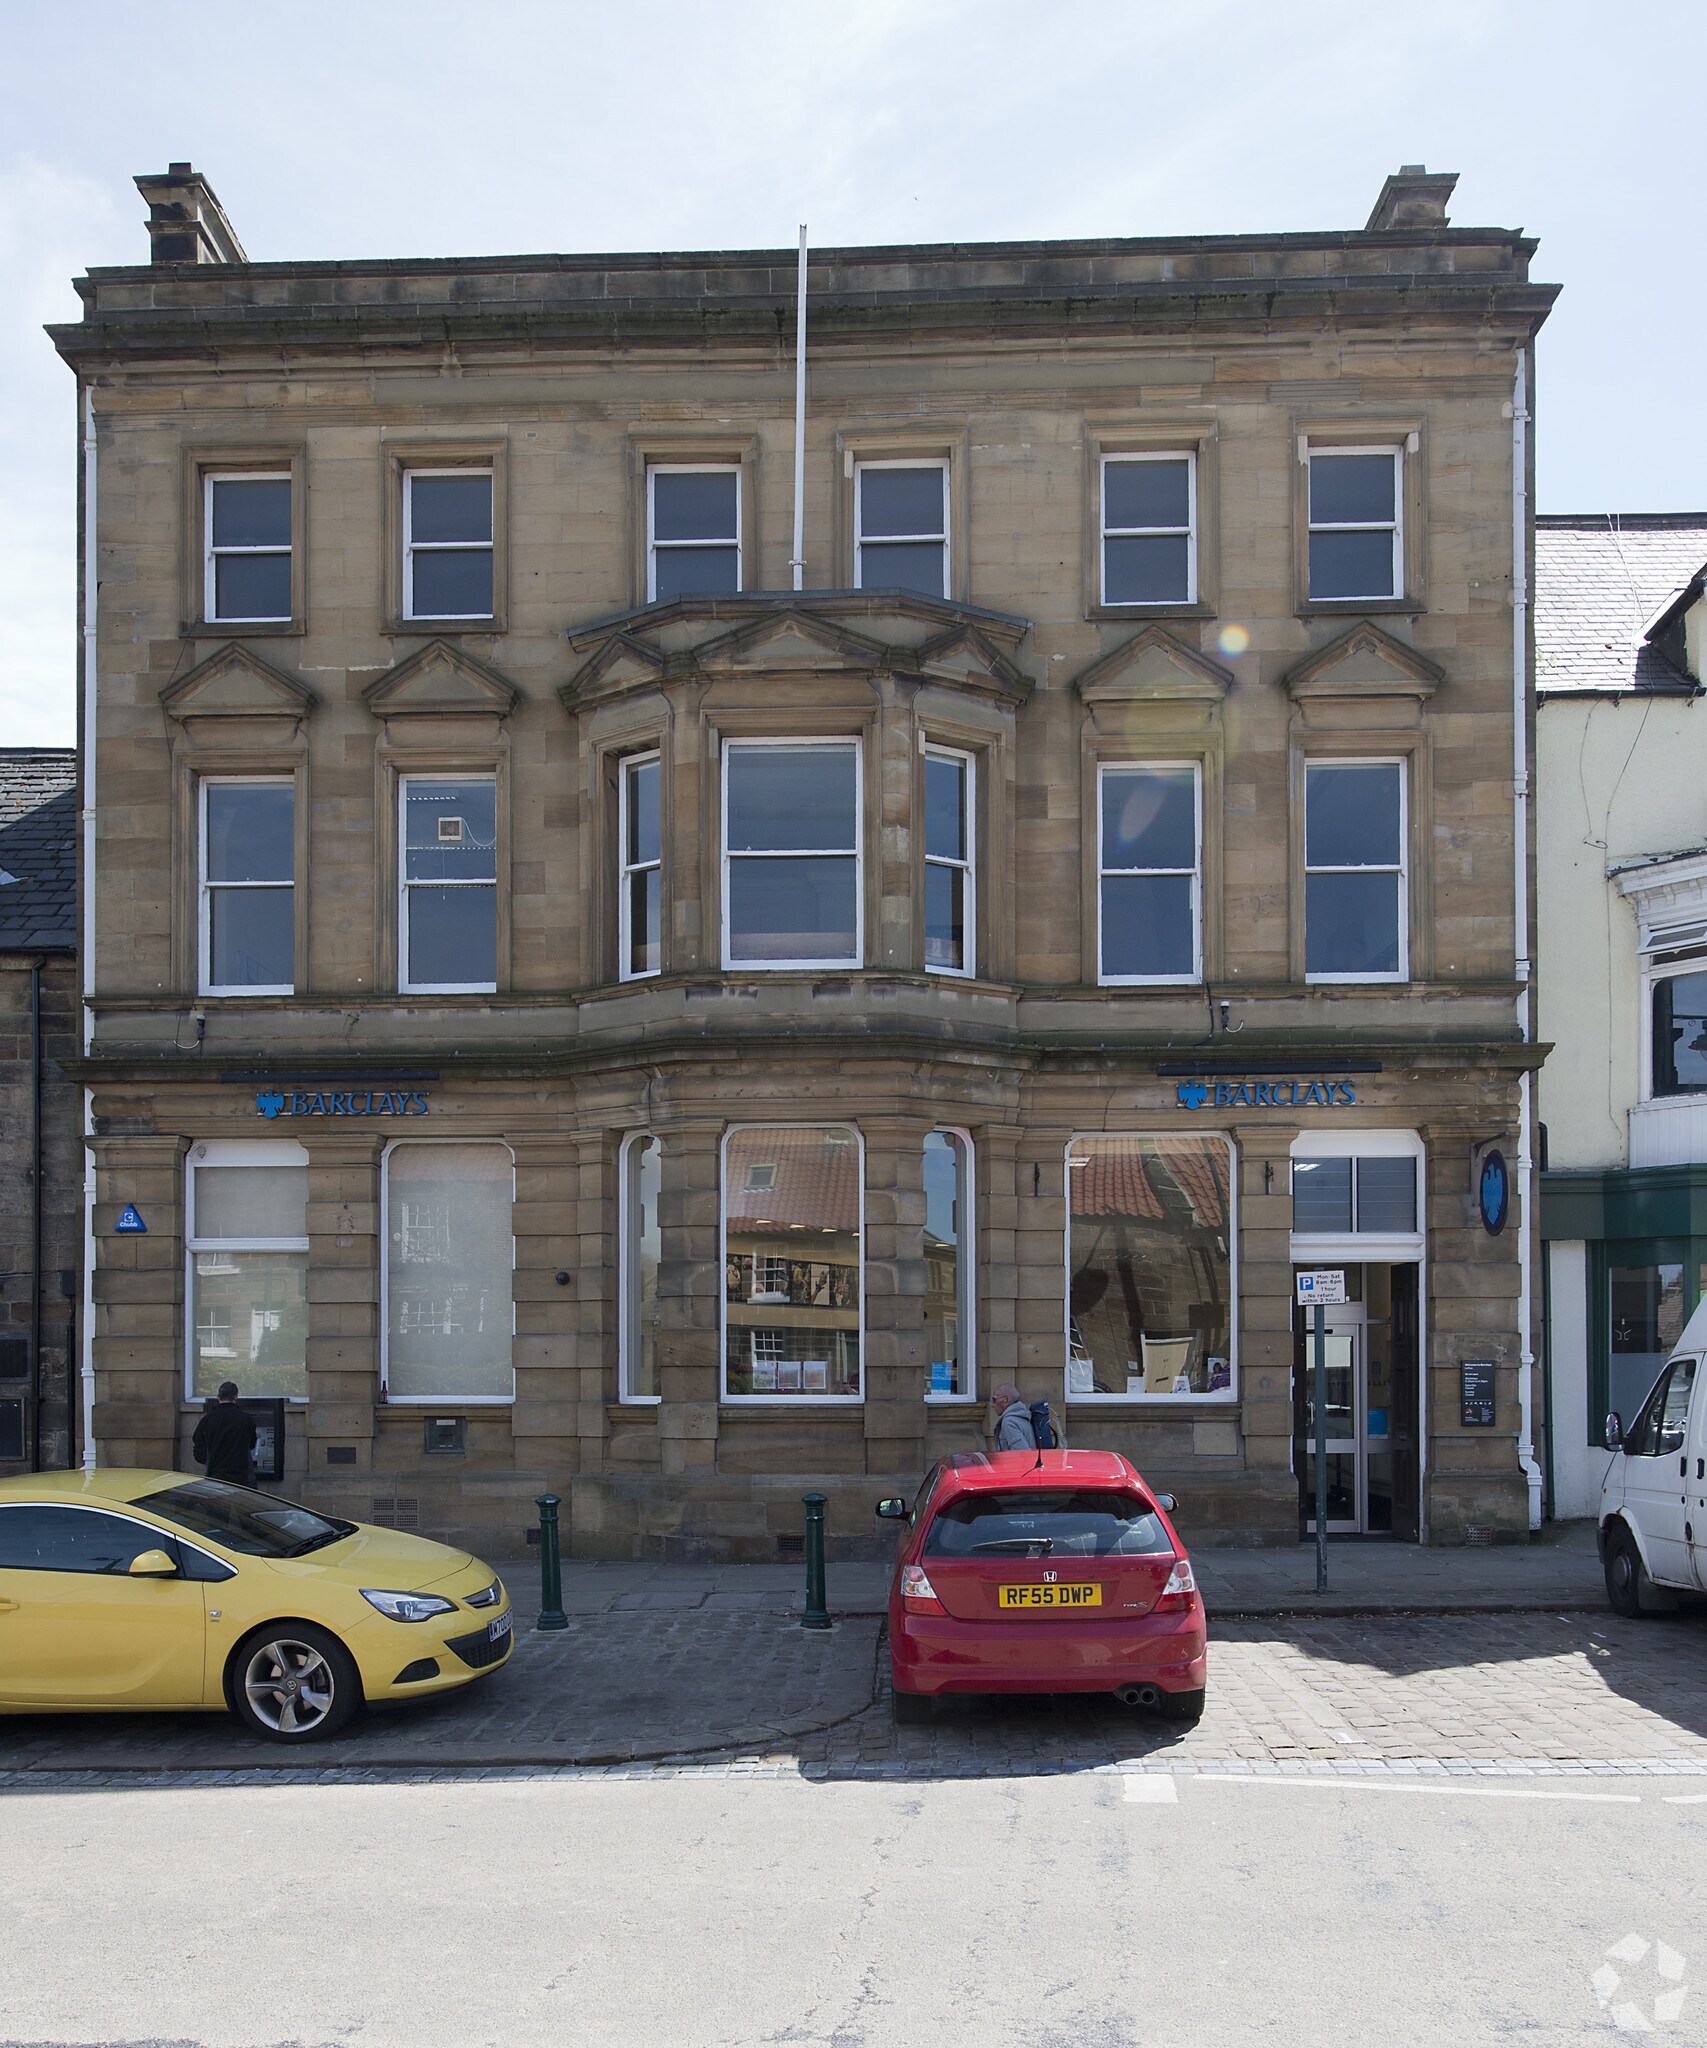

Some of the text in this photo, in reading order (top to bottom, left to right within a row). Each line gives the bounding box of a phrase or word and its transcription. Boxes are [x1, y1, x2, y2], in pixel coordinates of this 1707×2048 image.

[291, 1091, 428, 1116] BARCLAYS
[1214, 1081, 1356, 1106] BARCLAYS
[1302, 1278, 1312, 1290] P
[1007, 1587, 1094, 1605] RF55 DWP
